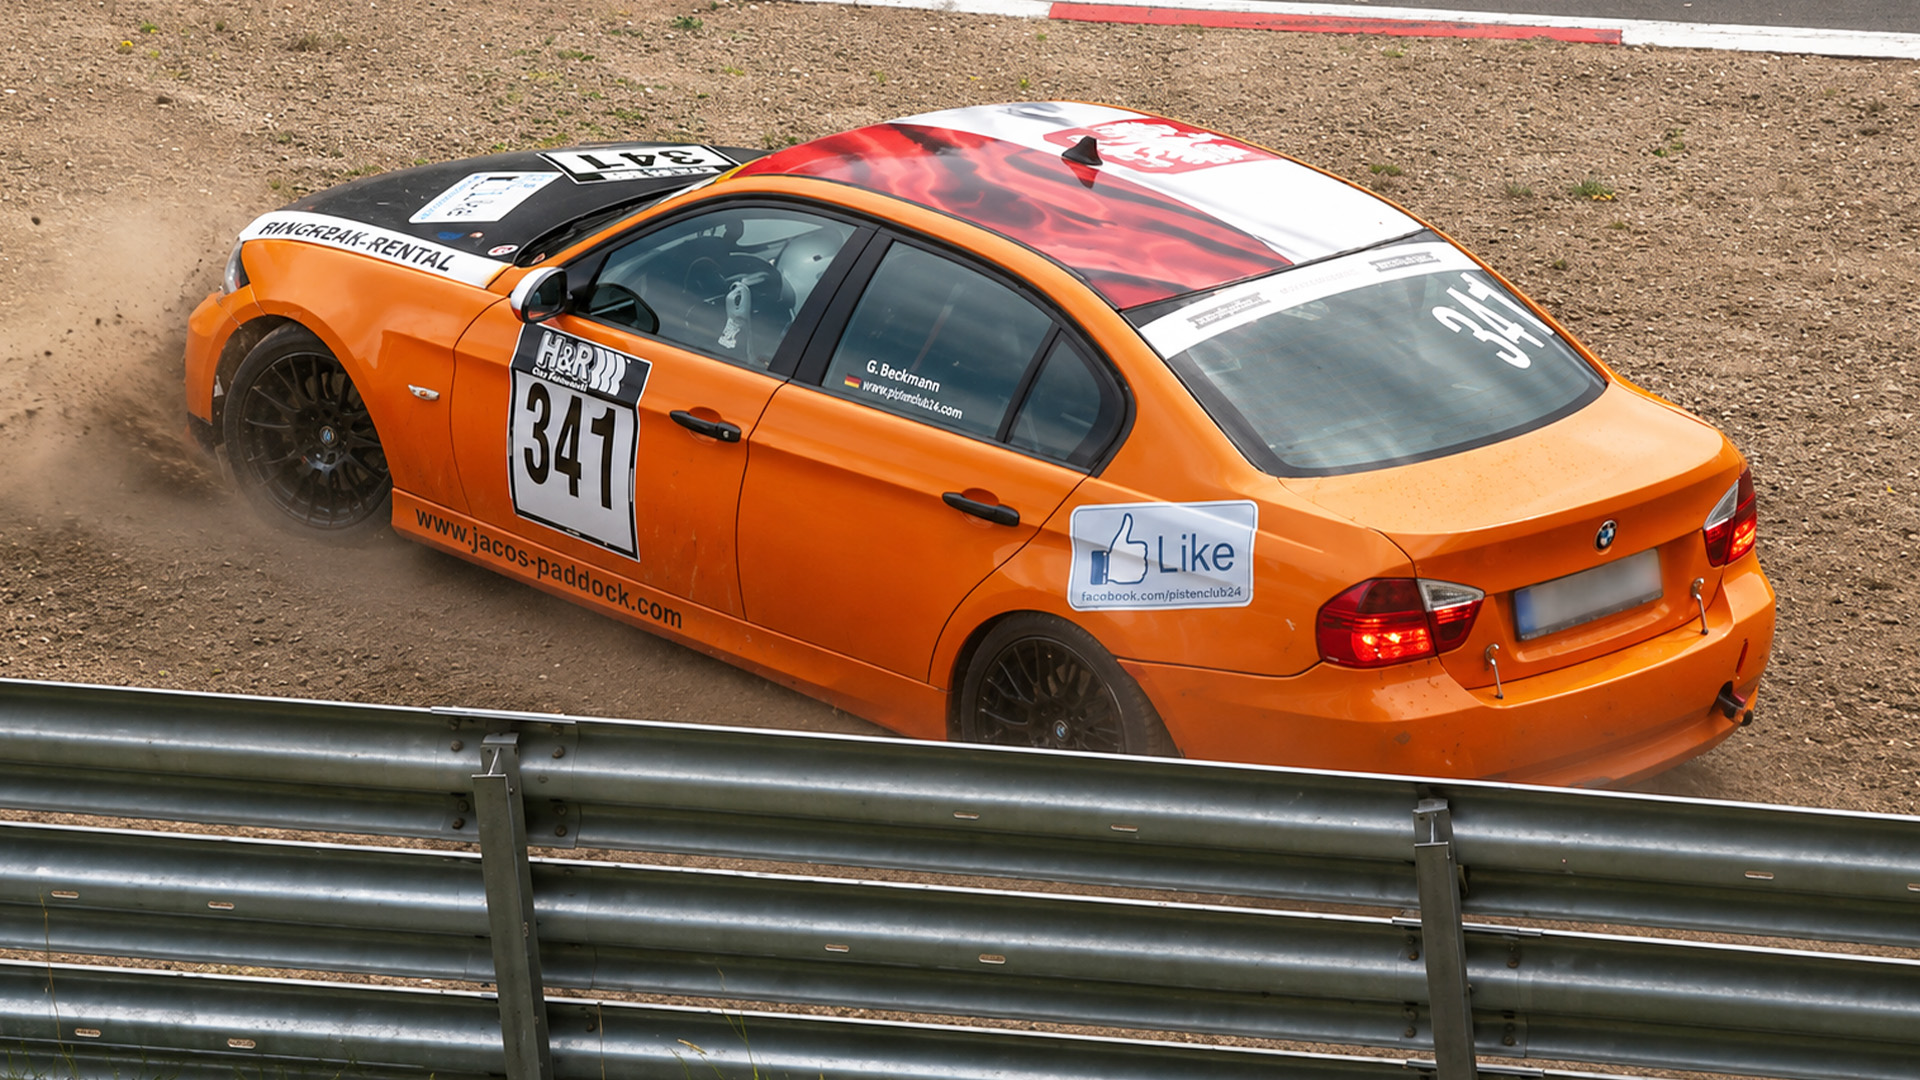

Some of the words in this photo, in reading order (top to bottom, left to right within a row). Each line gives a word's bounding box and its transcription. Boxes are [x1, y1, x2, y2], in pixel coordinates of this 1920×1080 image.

[576, 150, 705, 170] 341
[1432, 272, 1554, 369] 341
[536, 331, 594, 383] H&R
[866, 359, 878, 375] G.
[880, 363, 940, 393] Beckmann
[524, 382, 616, 510] 341
[416, 508, 682, 629] www.jacos-paddock.com
[1158, 533, 1234, 573] Like
